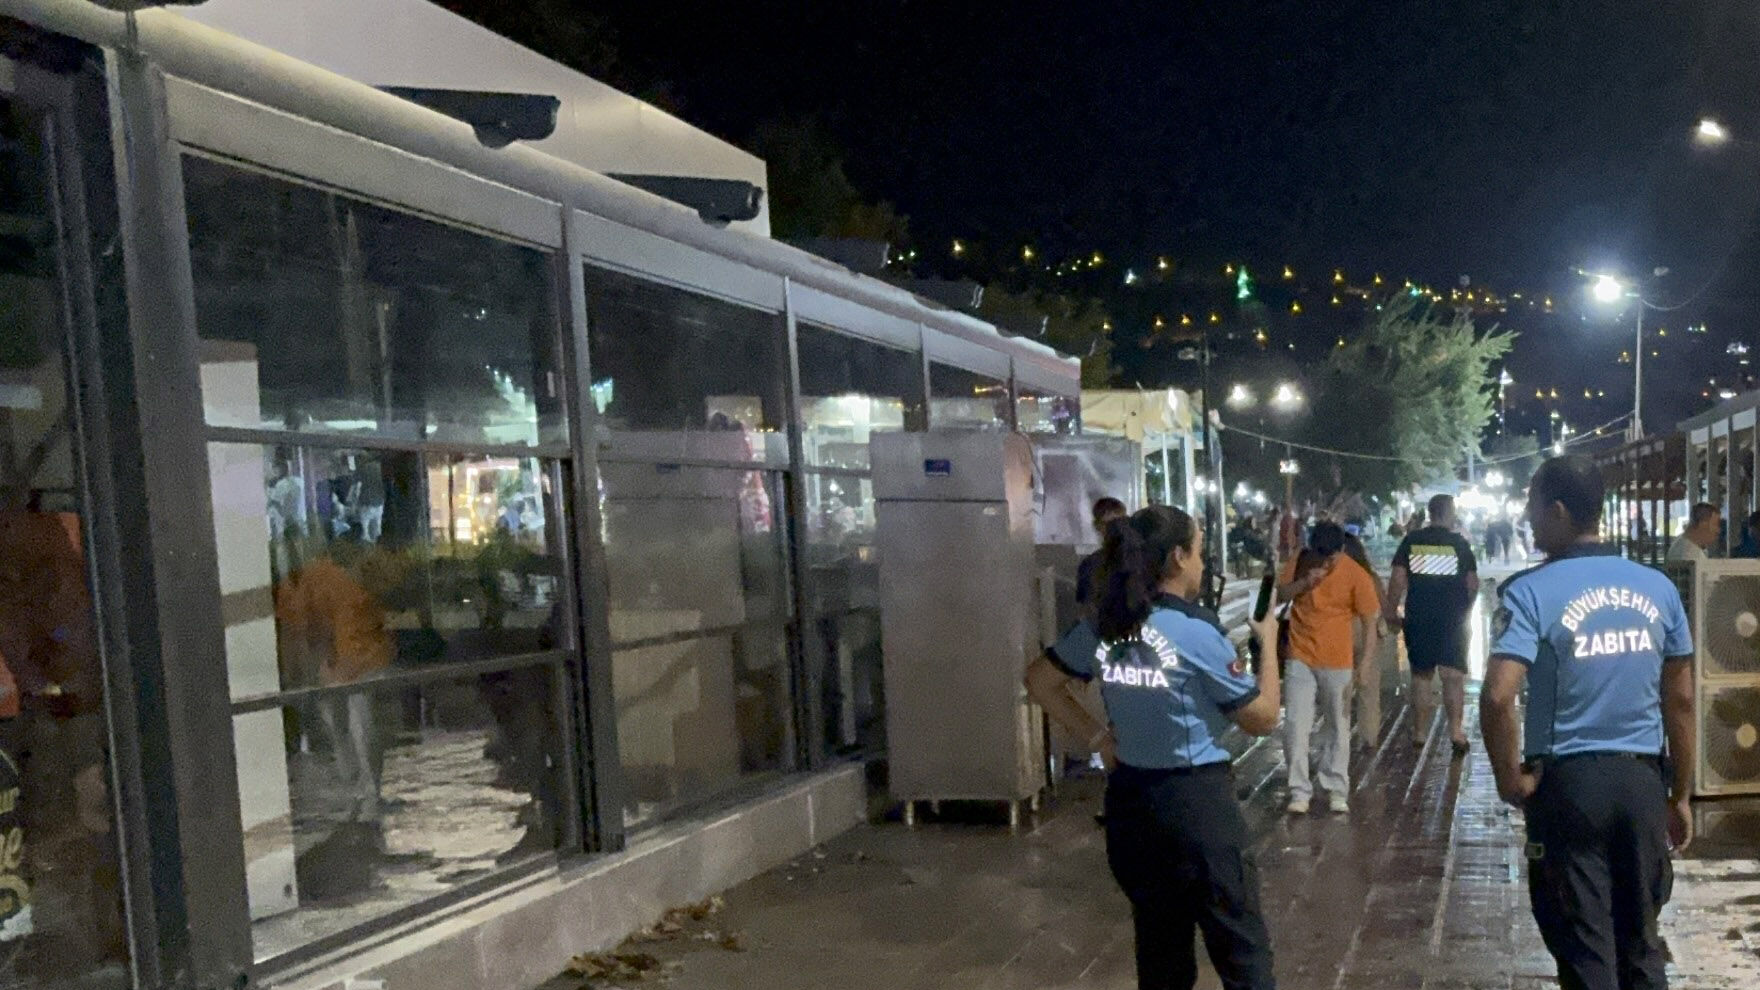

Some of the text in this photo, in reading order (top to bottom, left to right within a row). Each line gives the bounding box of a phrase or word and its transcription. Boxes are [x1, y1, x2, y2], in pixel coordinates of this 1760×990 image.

[1561, 586, 1660, 632] BÜYÜKŞEHİR
[1573, 628, 1652, 658] ZABITA
[1101, 664, 1170, 688] ZABITA
